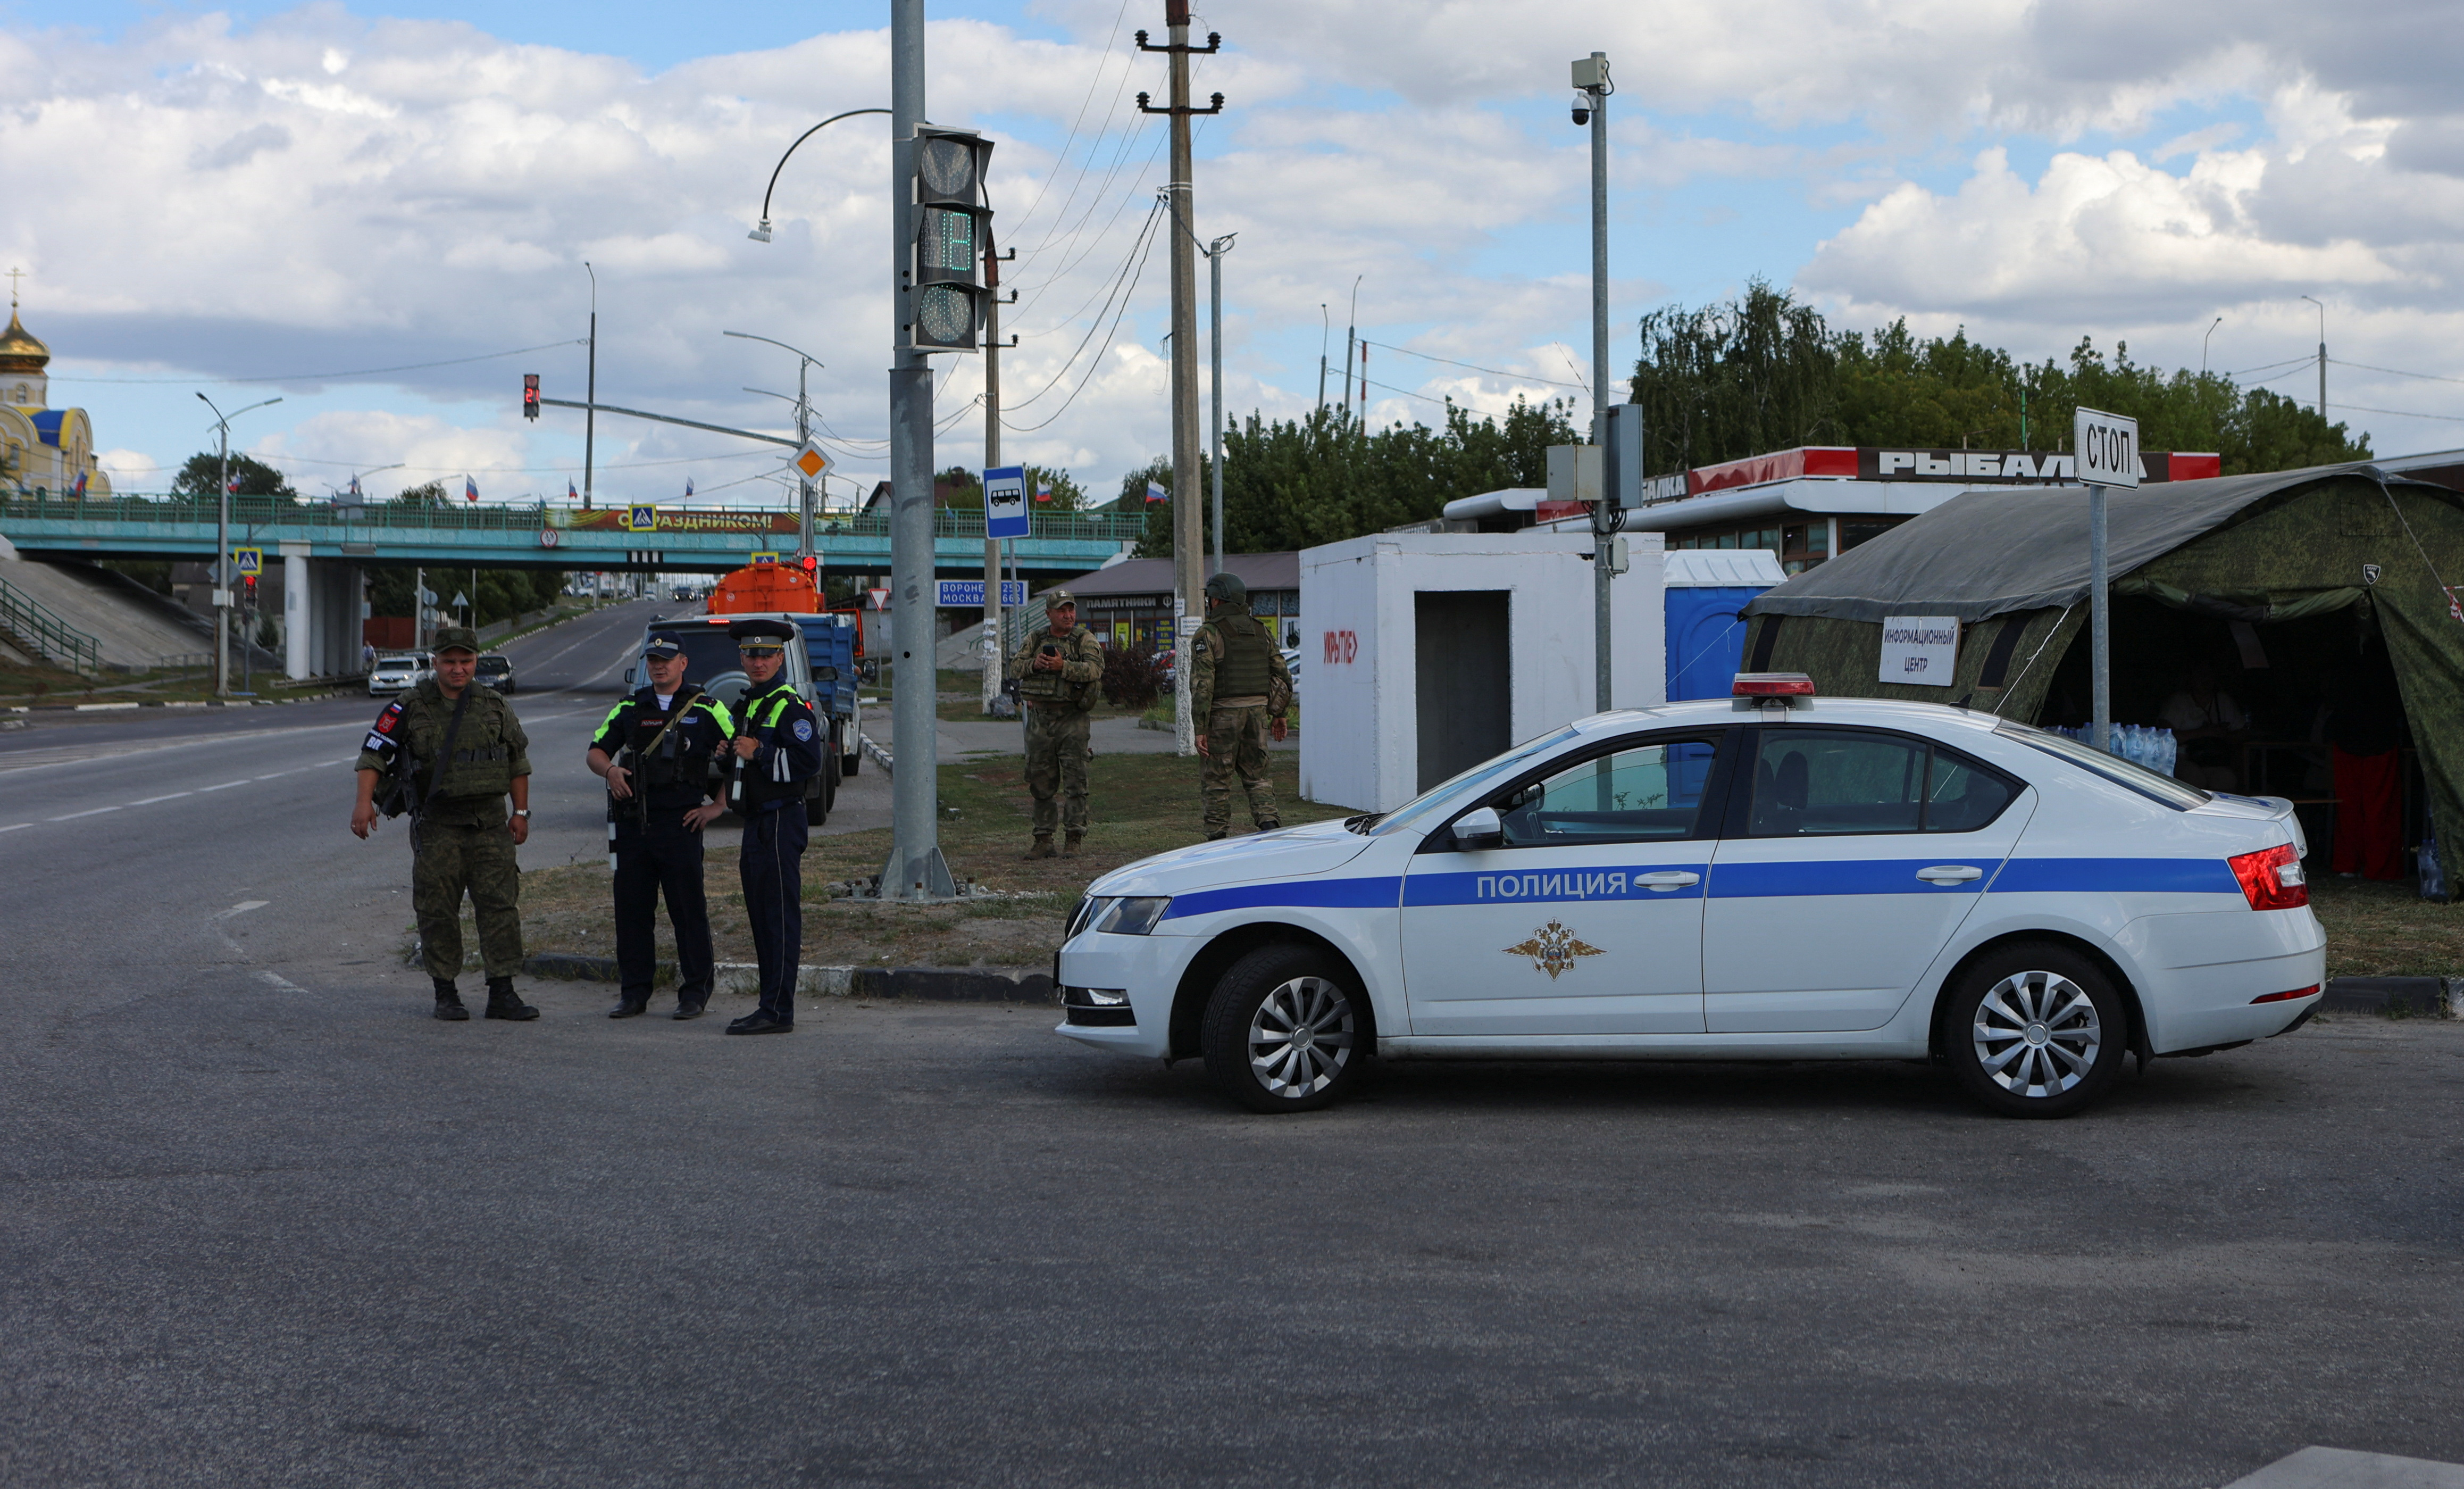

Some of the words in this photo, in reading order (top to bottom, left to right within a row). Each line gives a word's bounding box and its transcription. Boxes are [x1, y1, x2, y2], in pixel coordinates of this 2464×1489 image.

[525, 388, 539, 403] 21
[2087, 423, 2129, 474] СТОП
[1879, 452, 2147, 478] РЫБАЛ
[617, 513, 629, 527] С
[656, 514, 772, 530] АЗДНИКОМ!
[943, 584, 984, 592] ВОРОНЕ
[1087, 597, 1156, 608] ПАМЯТНИКИ
[1884, 626, 1955, 647] ИНФОРМАЦИОННЫЙ
[1324, 630, 1352, 664] УКРЫТИЕ
[1904, 657, 1928, 674] ЦЕНТР
[366, 736, 383, 751] ВП
[1477, 872, 1626, 899] ПОЛИЦИЯ
